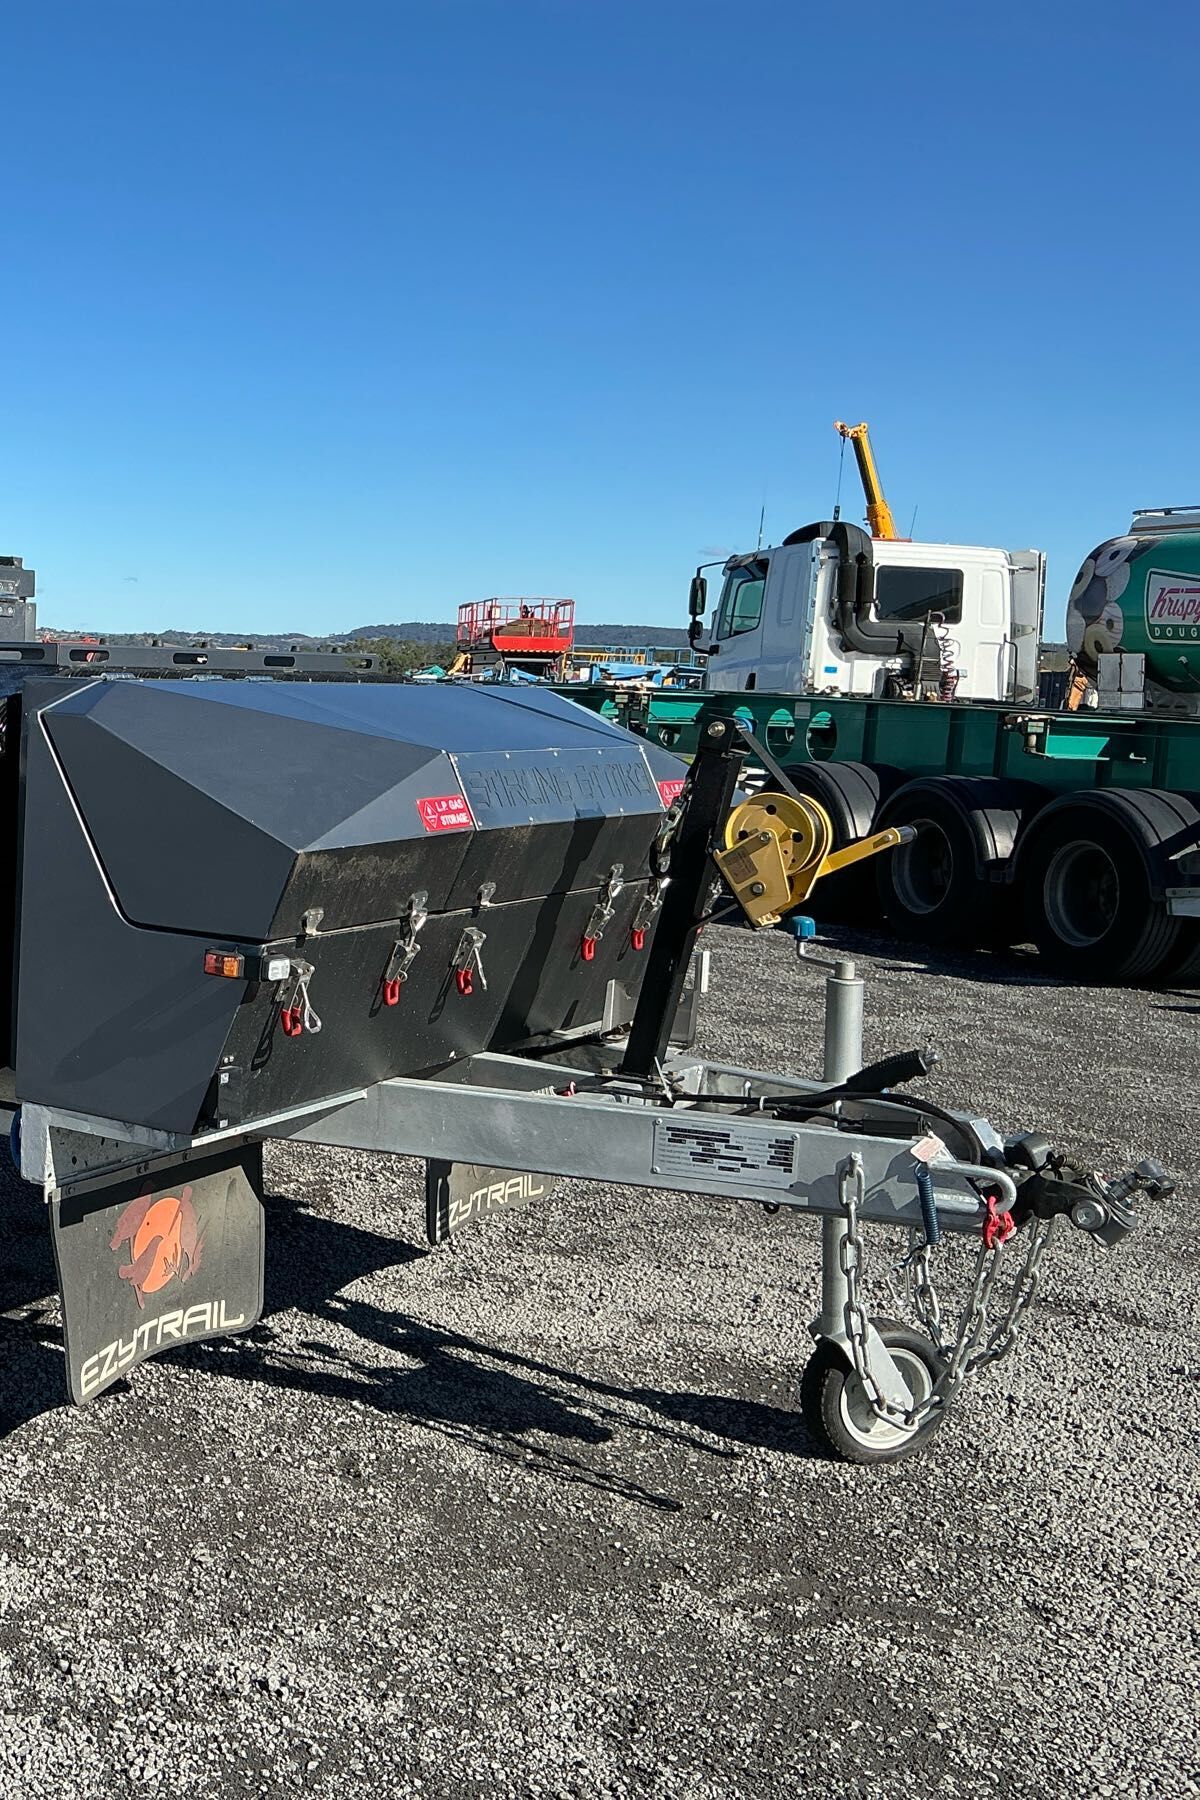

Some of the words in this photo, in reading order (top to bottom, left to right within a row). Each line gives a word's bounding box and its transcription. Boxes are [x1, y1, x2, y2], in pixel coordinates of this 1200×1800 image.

[448, 798, 464, 811] GAS
[440, 812, 470, 826] STORAGE
[80, 1299, 245, 1397] EZYTRAIL
